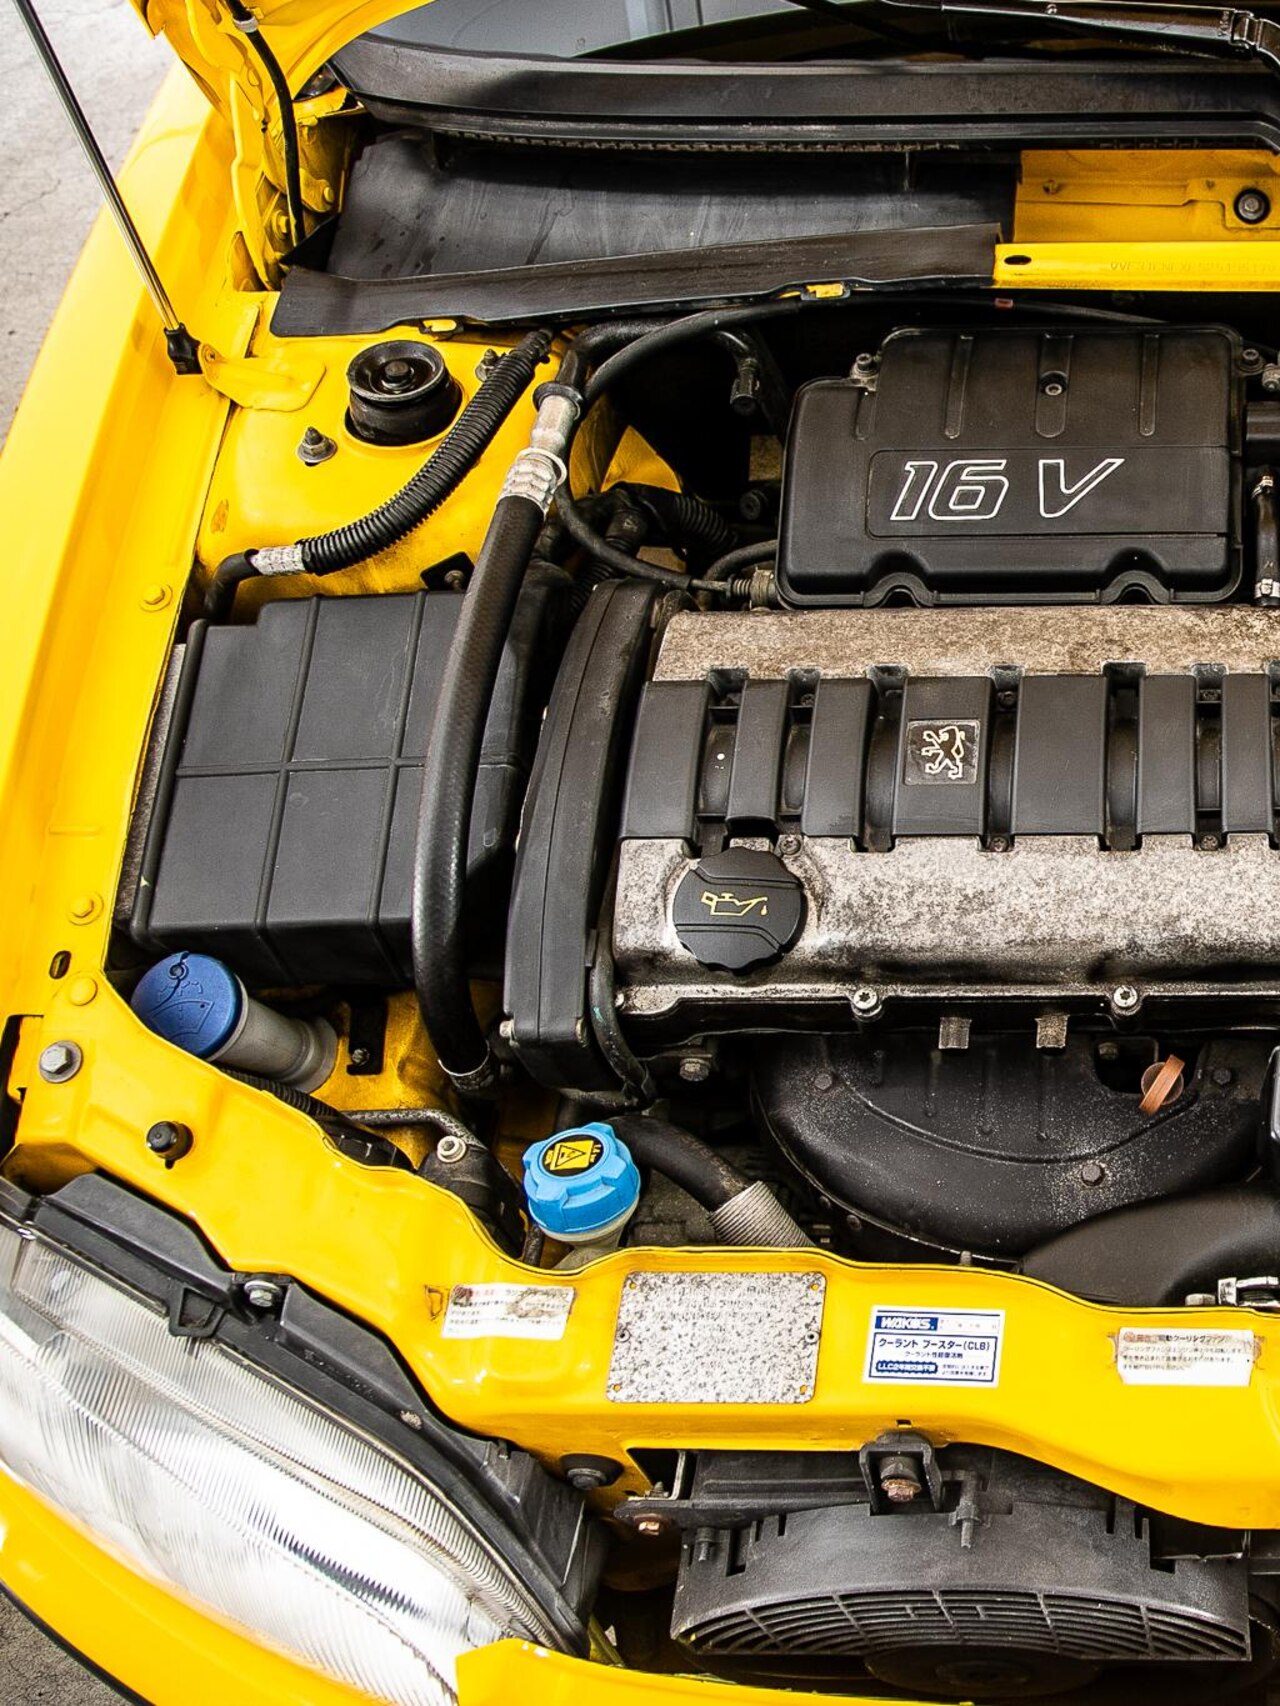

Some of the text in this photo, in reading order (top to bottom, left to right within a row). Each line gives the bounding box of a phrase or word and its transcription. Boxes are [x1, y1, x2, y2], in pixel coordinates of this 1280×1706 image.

[890, 458, 1125, 520] 16 V
[879, 1338, 919, 1348] クーラント
